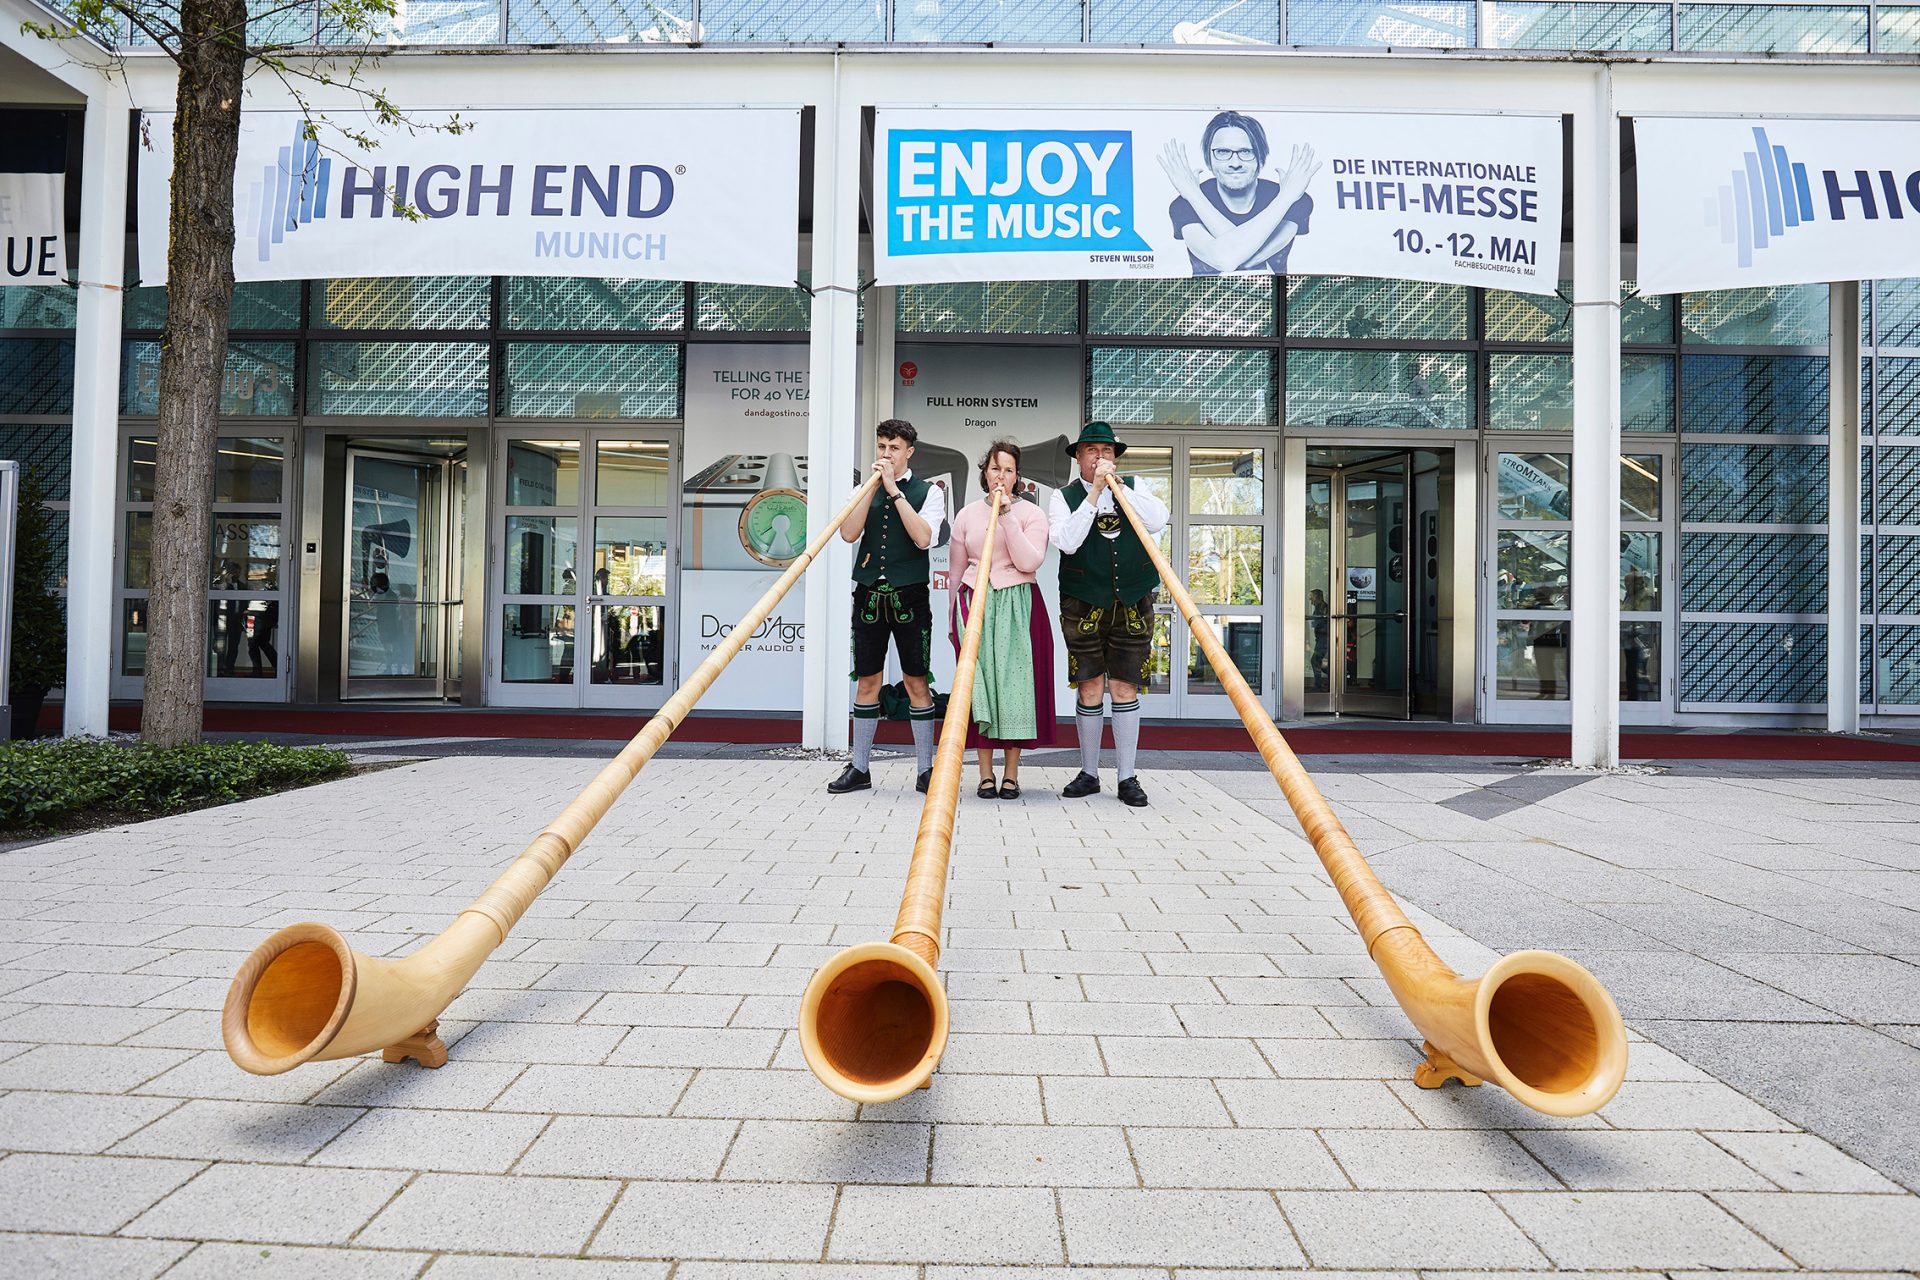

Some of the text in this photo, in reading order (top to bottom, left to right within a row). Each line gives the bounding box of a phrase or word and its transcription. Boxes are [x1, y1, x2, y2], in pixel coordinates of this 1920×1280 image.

[900, 141, 1124, 198] ENJOY
[1333, 158, 1537, 183] DIE INTERNATIONALE
[341, 164, 514, 219] HIGH
[1336, 180, 1538, 223] HIFI-MESSE
[896, 203, 1122, 242] THE MUSIC
[535, 231, 667, 261] MUNICH
[1490, 236, 1537, 266] MAI
[1089, 254, 1155, 263] STEVEN WILSON
[1454, 259, 1516, 275] FACHBESUCHERTAG
[1523, 268, 1536, 276] MAI
[262, 363, 279, 392] 3
[713, 370, 771, 383] TELLING
[775, 371, 803, 384] THE
[731, 387, 760, 401] FOR
[764, 391, 782, 402] 40
[926, 396, 1038, 409] FULL HORN SYSTEM
[744, 408, 810, 419] dandagostino.c
[964, 418, 997, 429] Dragon
[1503, 457, 1553, 492] STROMTANK
[701, 614, 737, 638] Da
[757, 644, 794, 652] AUDIO
